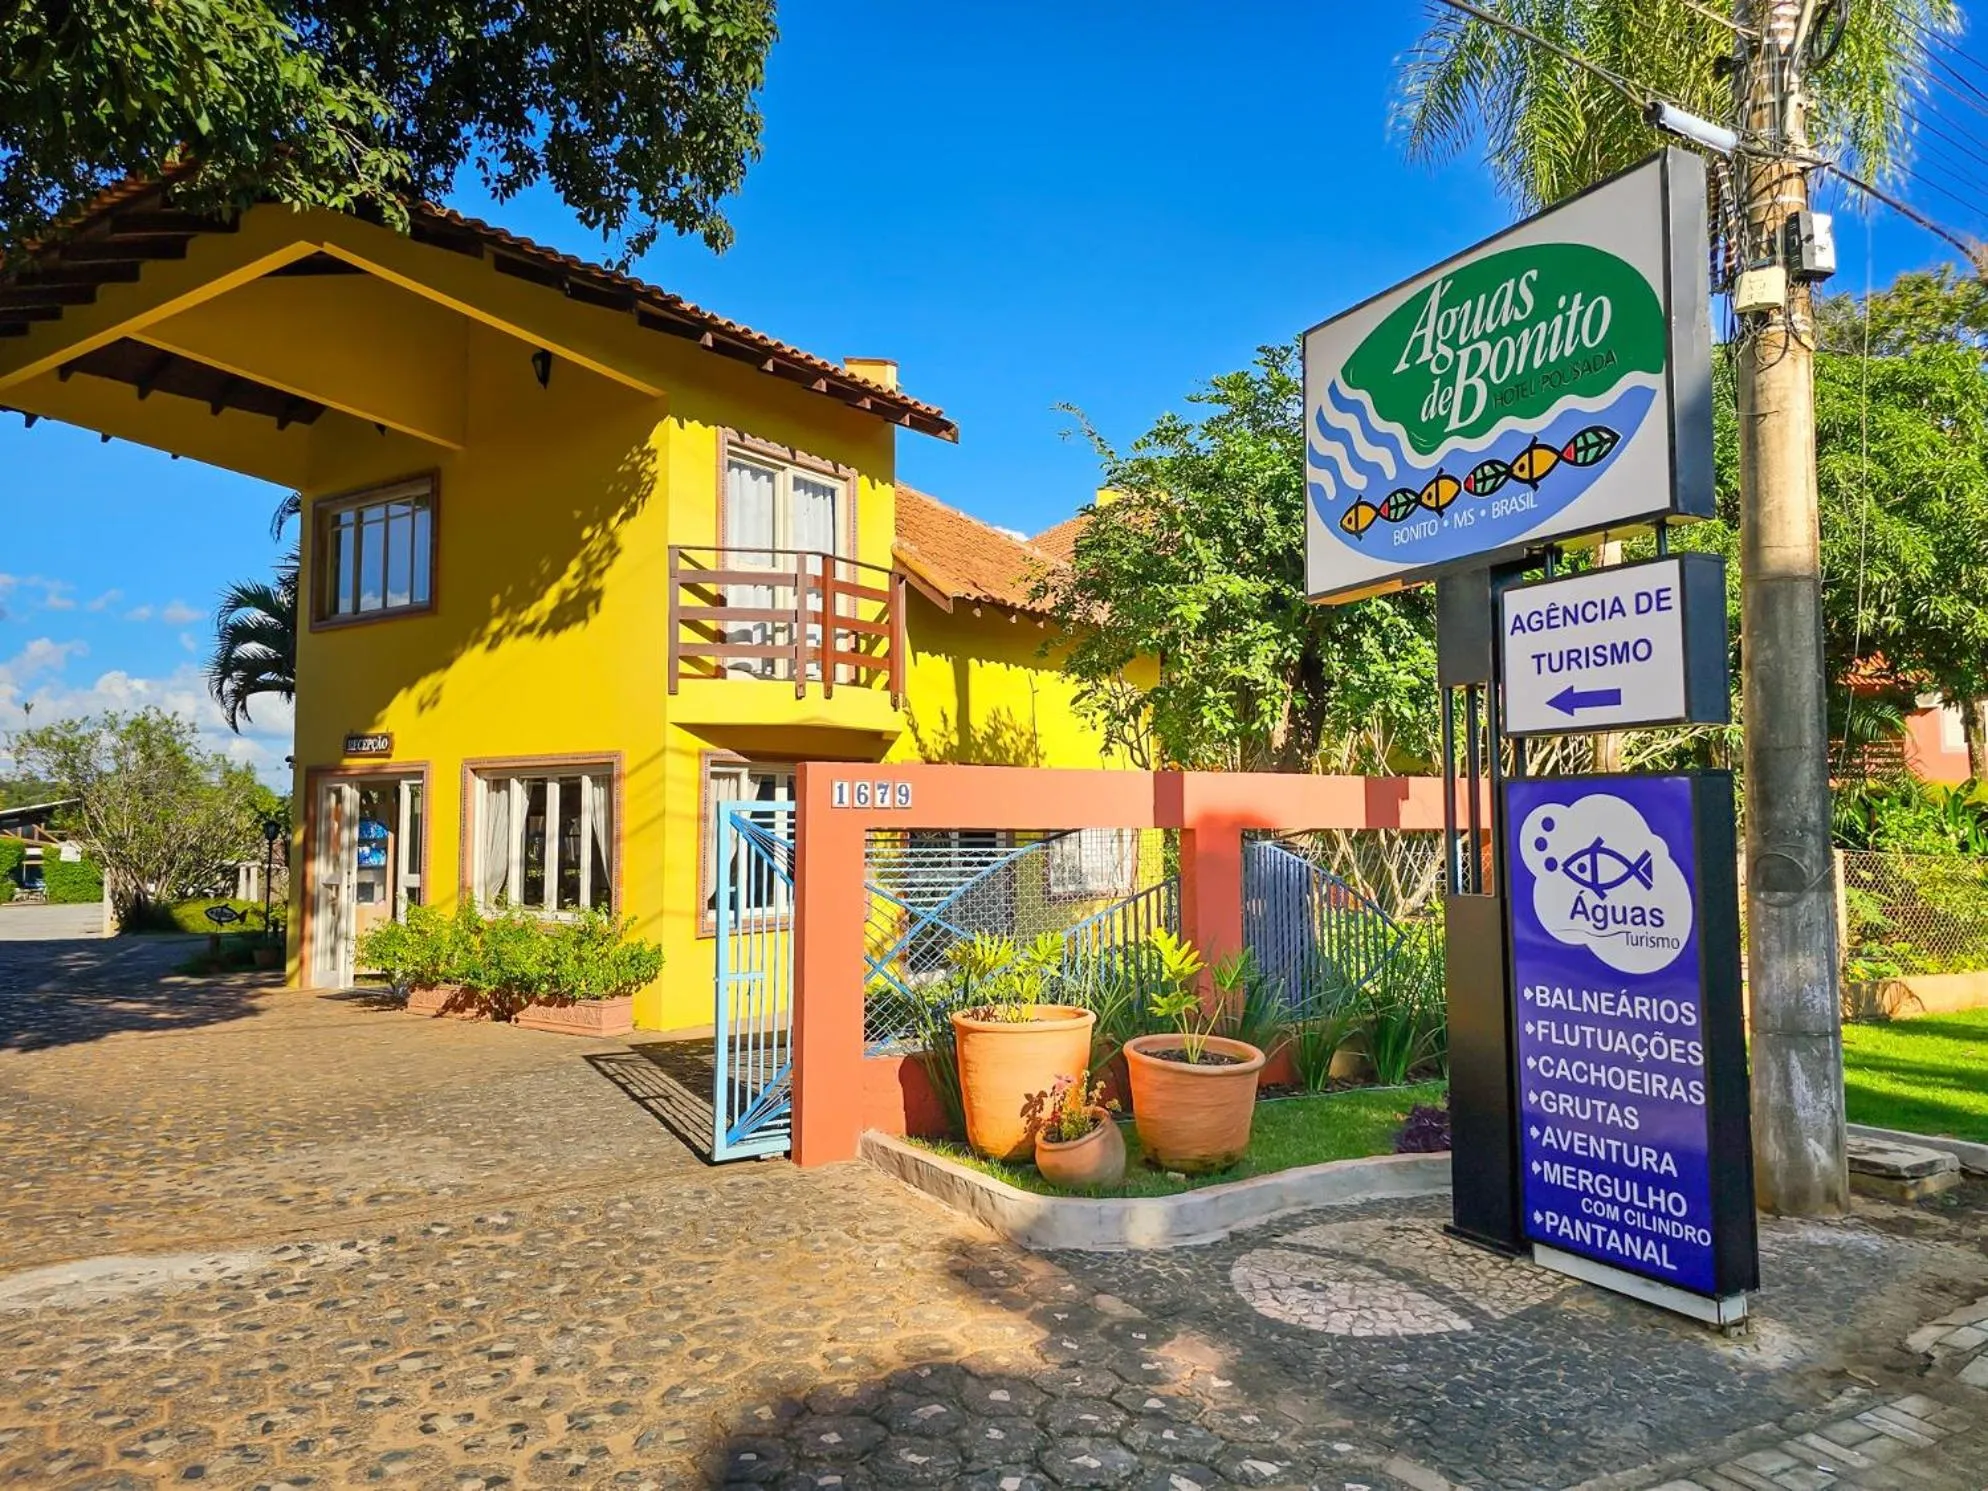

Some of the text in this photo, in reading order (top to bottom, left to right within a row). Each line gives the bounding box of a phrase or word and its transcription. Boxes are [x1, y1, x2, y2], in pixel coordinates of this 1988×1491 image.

[1392, 269, 1538, 375] Águas
[1420, 291, 1613, 433] de Bonito
[1492, 348, 1618, 409] HOTEL POUSADA
[1393, 491, 1538, 546] BONITO MS BRASIL
[1509, 586, 1673, 637] AGÊNCIA DE
[1531, 637, 1653, 676] TURISMO
[836, 782, 910, 806] 1679
[1569, 890, 1665, 931] Águas
[1624, 931, 1681, 950] Turismo
[1534, 985, 1698, 1027] BALNEÁRIOS
[1537, 1020, 1705, 1066] FLUTUAÇÕES
[1538, 1055, 1707, 1106] CACHOEIRAS
[1540, 1090, 1640, 1131] GRUTAS
[1541, 1126, 1679, 1178] AVENTURA
[1543, 1160, 1688, 1218] MERGULHO
[1545, 1211, 1678, 1271] PANTANAL
[1580, 1197, 1712, 1247] COM CILINDRO
